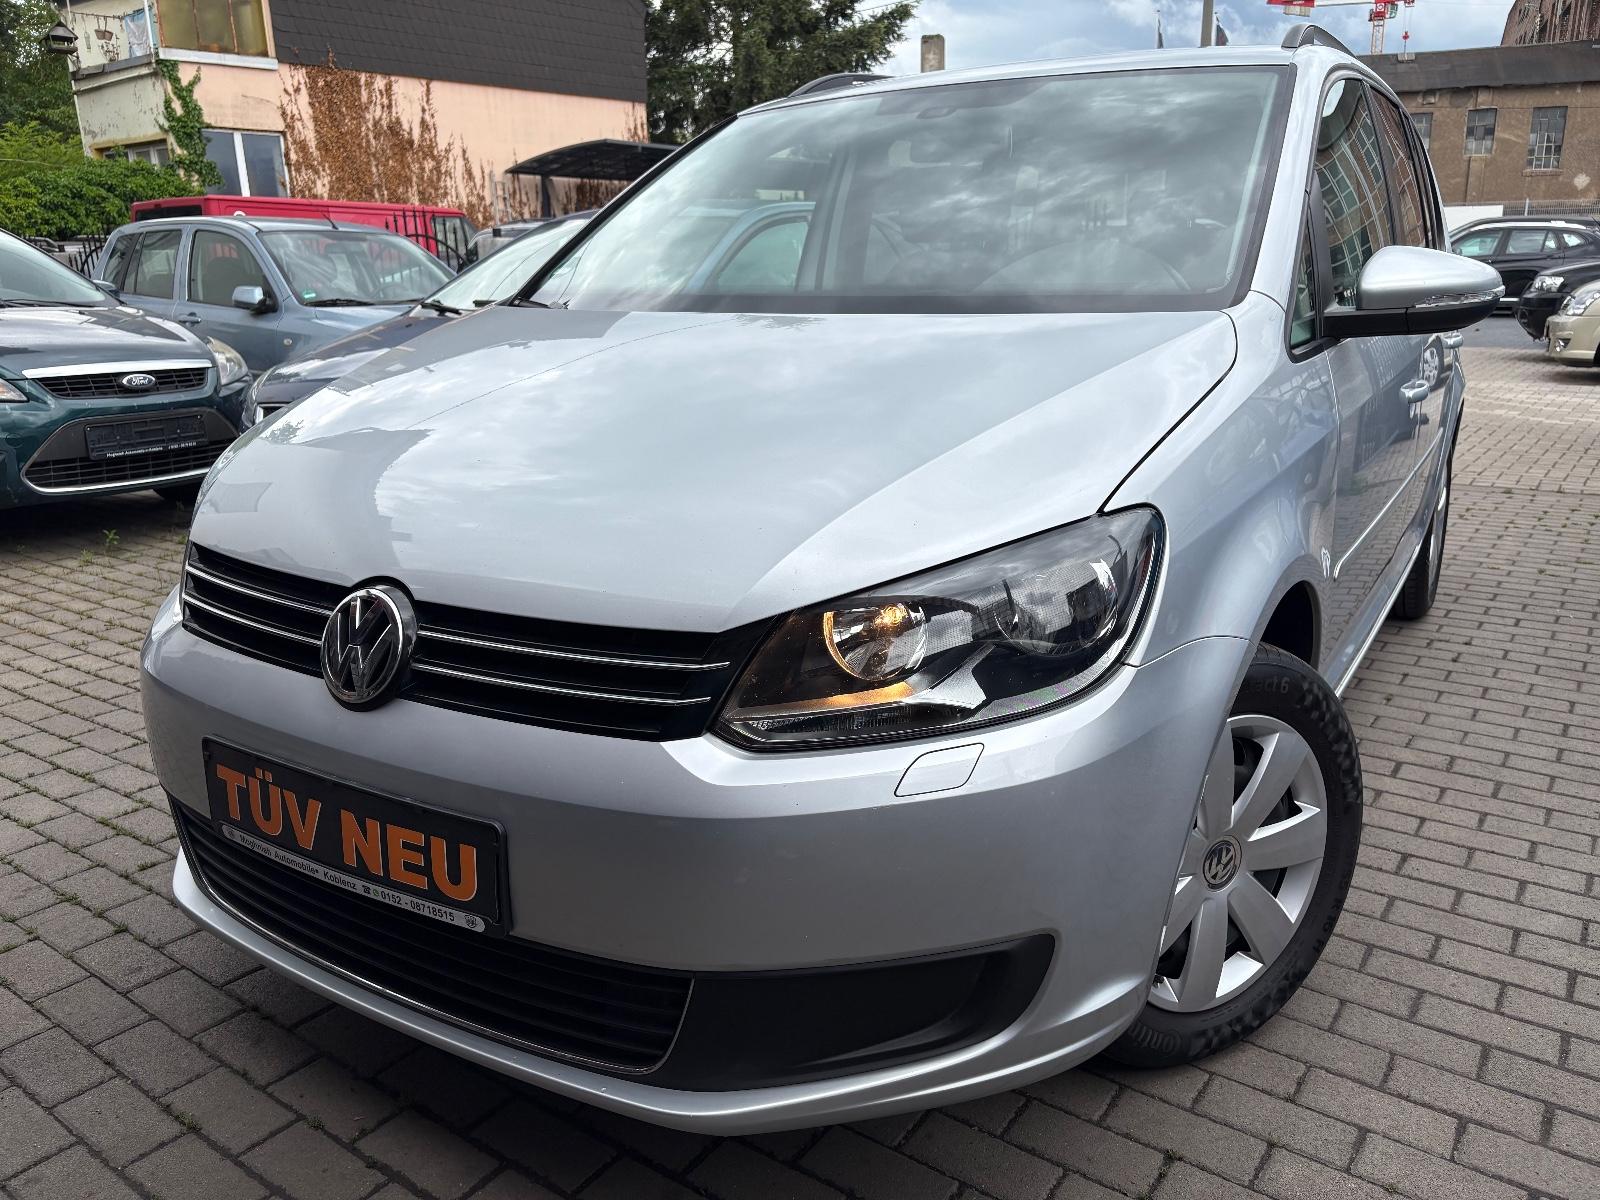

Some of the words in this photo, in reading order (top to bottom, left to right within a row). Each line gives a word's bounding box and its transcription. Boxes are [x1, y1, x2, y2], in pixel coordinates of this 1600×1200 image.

[131, 376, 149, 386] Ford
[216, 763, 322, 850] TÜV
[340, 809, 478, 902] NEU
[323, 871, 358, 891] Koblenz
[381, 890, 402, 905] 0152
[410, 901, 455, 922] 08718515
